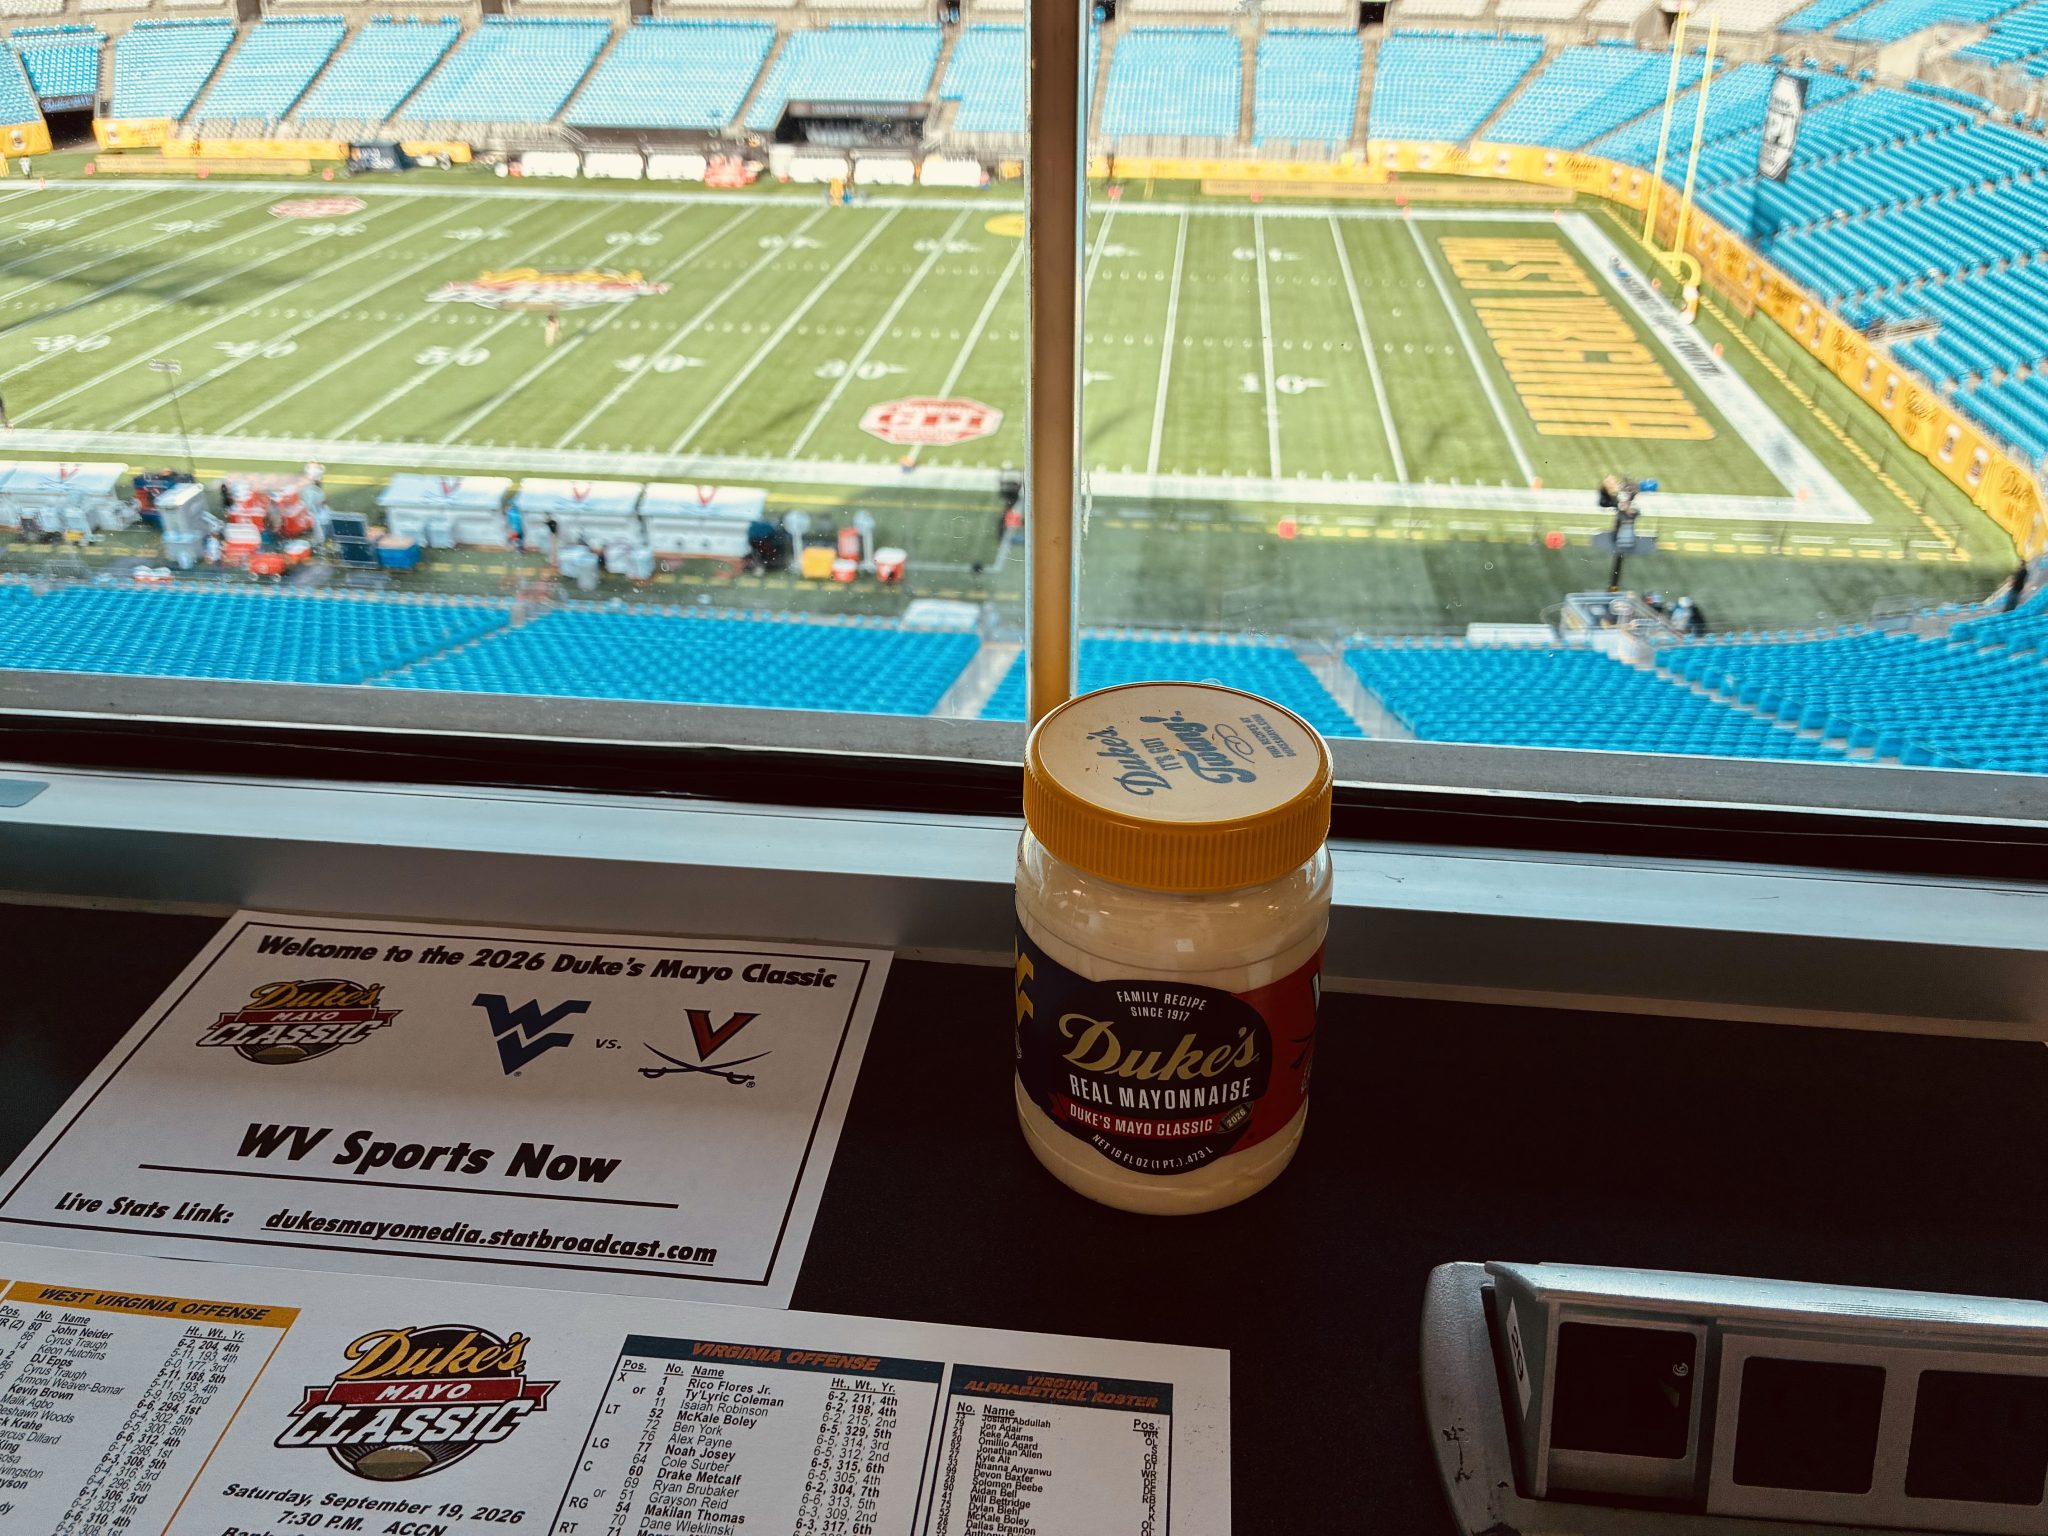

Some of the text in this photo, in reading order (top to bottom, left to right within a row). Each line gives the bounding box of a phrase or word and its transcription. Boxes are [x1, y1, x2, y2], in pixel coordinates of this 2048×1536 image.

[1139, 737, 1169, 754] GOT
[1139, 716, 1257, 784] Twang!
[256, 935, 839, 988] Welcome to the 2026 Duke's Mayo Classic
[244, 981, 386, 1010] Duke's
[1116, 990, 1207, 1011] FAMILY RECIPE
[270, 1011, 341, 1022] MAYO
[1130, 1006, 1191, 1022] SINCE 1917
[197, 1019, 385, 1047] CLASSIC
[594, 1038, 622, 1050] vs.
[1058, 1013, 1258, 1081] Duke's
[1069, 1074, 1252, 1110] REAL MAYONNAISE
[1069, 1104, 1247, 1136] DUKE'S MAYO CLASSIC 2026
[236, 1123, 622, 1184] WV Sports Now
[1092, 1134, 1110, 1151] NET
[1111, 1146, 1123, 1159] 16
[1123, 1153, 1134, 1165] FL
[1136, 1157, 1148, 1168] OZ
[54, 1192, 718, 1263] Live Stats Link: dukesmayomedia.statbroadcast.com
[39, 1289, 270, 1320] WEST VIRGINIA OFFENSE
[0, 1306, 20, 1317] Pos.
[36, 1310, 53, 1320] No.
[60, 1313, 91, 1324] Name
[233, 1330, 245, 1340] Yr.
[28, 1322, 240, 1352] 80 John Neider 6-2, 204, 4th
[45, 1334, 108, 1352] Cyrus Traugh
[38, 1344, 106, 1360] Keon Hutchins
[337, 1325, 531, 1379] Duke's
[693, 1343, 881, 1371] VIRGINIA OFFENSE
[24, 1363, 87, 1381] Cyrus Traugh
[30, 1354, 226, 1384] DJ Epps 5-11, 188, 5th
[623, 1360, 647, 1371] Pos.
[666, 1363, 684, 1374] No.
[692, 1366, 724, 1377] Name
[882, 1382, 896, 1393] Yr.
[8, 1383, 74, 1400] Kevin Brown
[15, 1374, 125, 1395] Armoni Weaver-Bomar
[375, 1383, 472, 1401] MAYO
[688, 1378, 898, 1406] Rico Flores Jr. 6-2, 211, 4th
[1027, 1375, 1098, 1391] VIRGINIA
[1, 1394, 54, 1410] Malik Agbo
[685, 1388, 784, 1408] Ty'Lyric Coleman
[964, 1381, 1159, 1408] ALPHABETICAL ROSTER
[41, 1410, 75, 1424] Woods
[605, 1404, 757, 1429] LT 52 McKale Boley
[680, 1400, 768, 1418] Isaiah Robinson
[957, 1402, 1158, 1430] No. Name Pos.
[10, 1418, 42, 1430] Krahe
[277, 1400, 536, 1445] CLASSIC
[673, 1421, 723, 1436] Ben York
[1014, 1417, 1051, 1428] Abdullah
[26, 1431, 62, 1445] Dillard
[668, 1433, 733, 1449] Alex Payne
[980, 1430, 1034, 1442] Keke Adams
[665, 1444, 736, 1463] Noah Josey
[661, 1456, 730, 1473] Cole Surber
[1011, 1465, 1052, 1476] Anyanwu
[657, 1468, 742, 1485] Drake Metcalf
[652, 1479, 740, 1498] Ryan Brubaker
[222, 1484, 526, 1524] Saturday, September 19, 2026
[569, 1496, 746, 1524] RG 54 Makilan Thomas
[649, 1491, 729, 1510] Grayson Reid
[277, 1510, 321, 1527] 7:30
[325, 1515, 363, 1531] P.M.
[383, 1520, 448, 1536] ACCN
[640, 1517, 672, 1531] Dane
